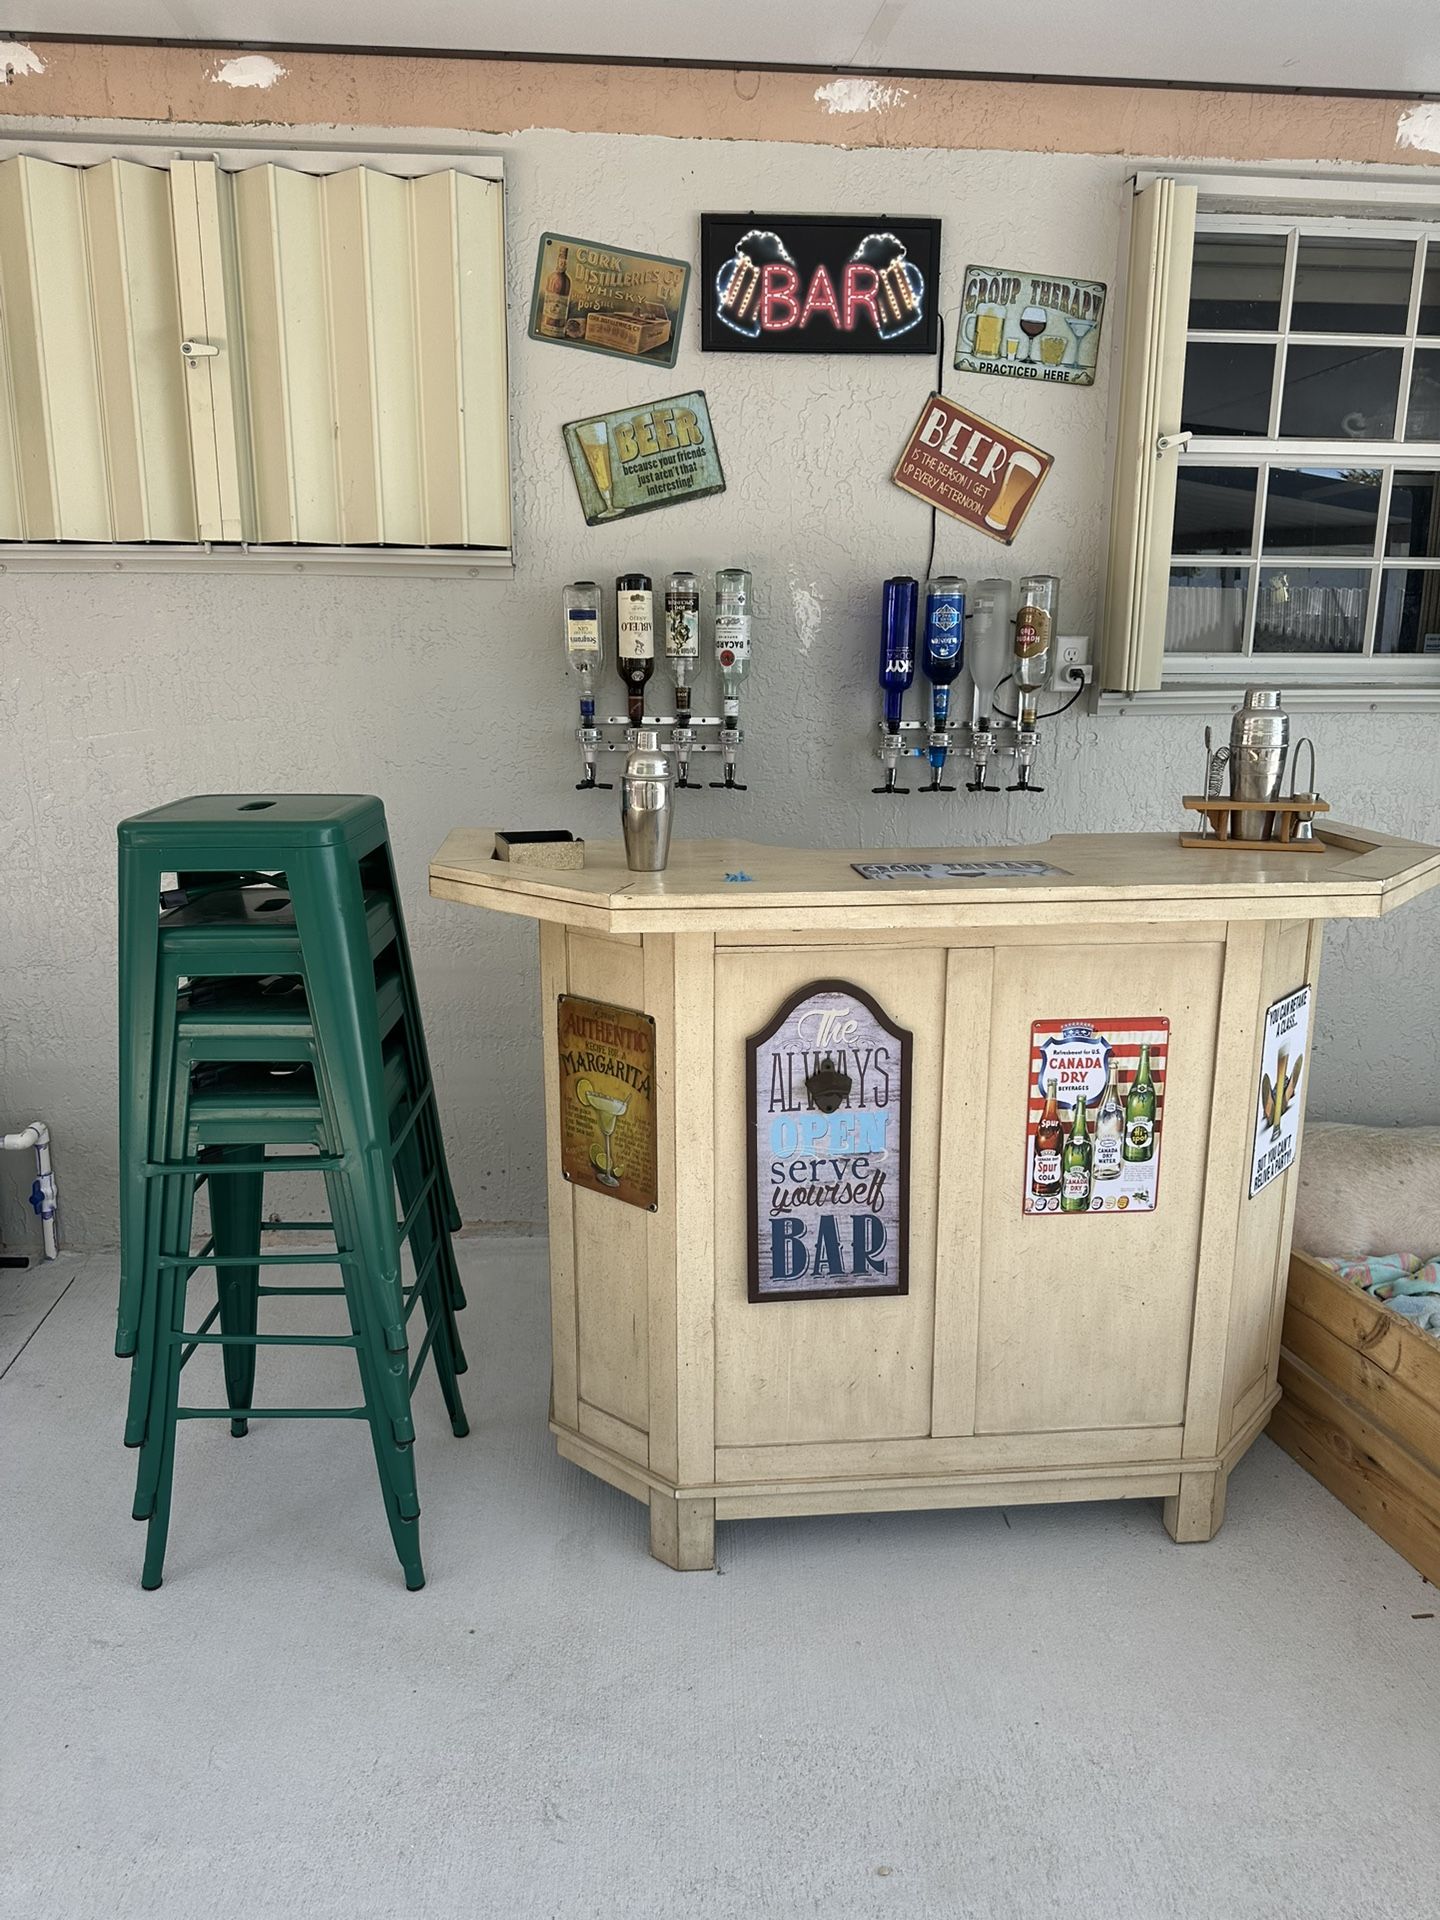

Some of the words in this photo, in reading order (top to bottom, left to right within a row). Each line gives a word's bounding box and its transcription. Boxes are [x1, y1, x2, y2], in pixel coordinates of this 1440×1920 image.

[576, 247, 623, 272] CORK
[575, 263, 660, 287] DISTILLERIES
[584, 283, 647, 304] WHISKY
[761, 263, 882, 331] BAR
[965, 277, 1021, 314] GROUP
[1030, 279, 1102, 320] THERAPY
[978, 362, 1038, 379] PRACTICED
[1043, 370, 1071, 382] HERE
[614, 407, 704, 464] BEER
[918, 406, 1008, 484] BEER
[622, 458, 658, 476] because
[658, 453, 677, 469] your
[676, 446, 707, 464] friends
[636, 473, 654, 488] just
[654, 467, 678, 481] aren't
[679, 461, 698, 474] that
[911, 447, 920, 461] IS
[921, 451, 938, 471] THE
[936, 460, 967, 488] REASON
[972, 481, 991, 499] GET
[646, 475, 694, 497] interesting!
[902, 462, 913, 476] UP
[913, 468, 940, 489] EVERY
[1270, 1008, 1280, 1026] YOU
[1280, 1001, 1290, 1020] CAN
[563, 1014, 648, 1053] AUTHENTIC
[798, 1007, 859, 1048] The
[586, 1041, 607, 1056] RECIPE
[560, 1050, 651, 1101] MARGARITA
[1049, 1058, 1102, 1069] CANADA
[1060, 1072, 1088, 1083] DRY
[770, 1112, 890, 1158] OPEN
[1041, 1119, 1059, 1128] Spur
[1257, 1153, 1267, 1174] BUT
[1268, 1145, 1277, 1165] YOU
[1277, 1134, 1292, 1157] CAN'T
[771, 1157, 869, 1184] serve
[1038, 1162, 1057, 1174] Spur
[770, 1169, 887, 1216] yourself
[769, 1215, 888, 1283] BAR
